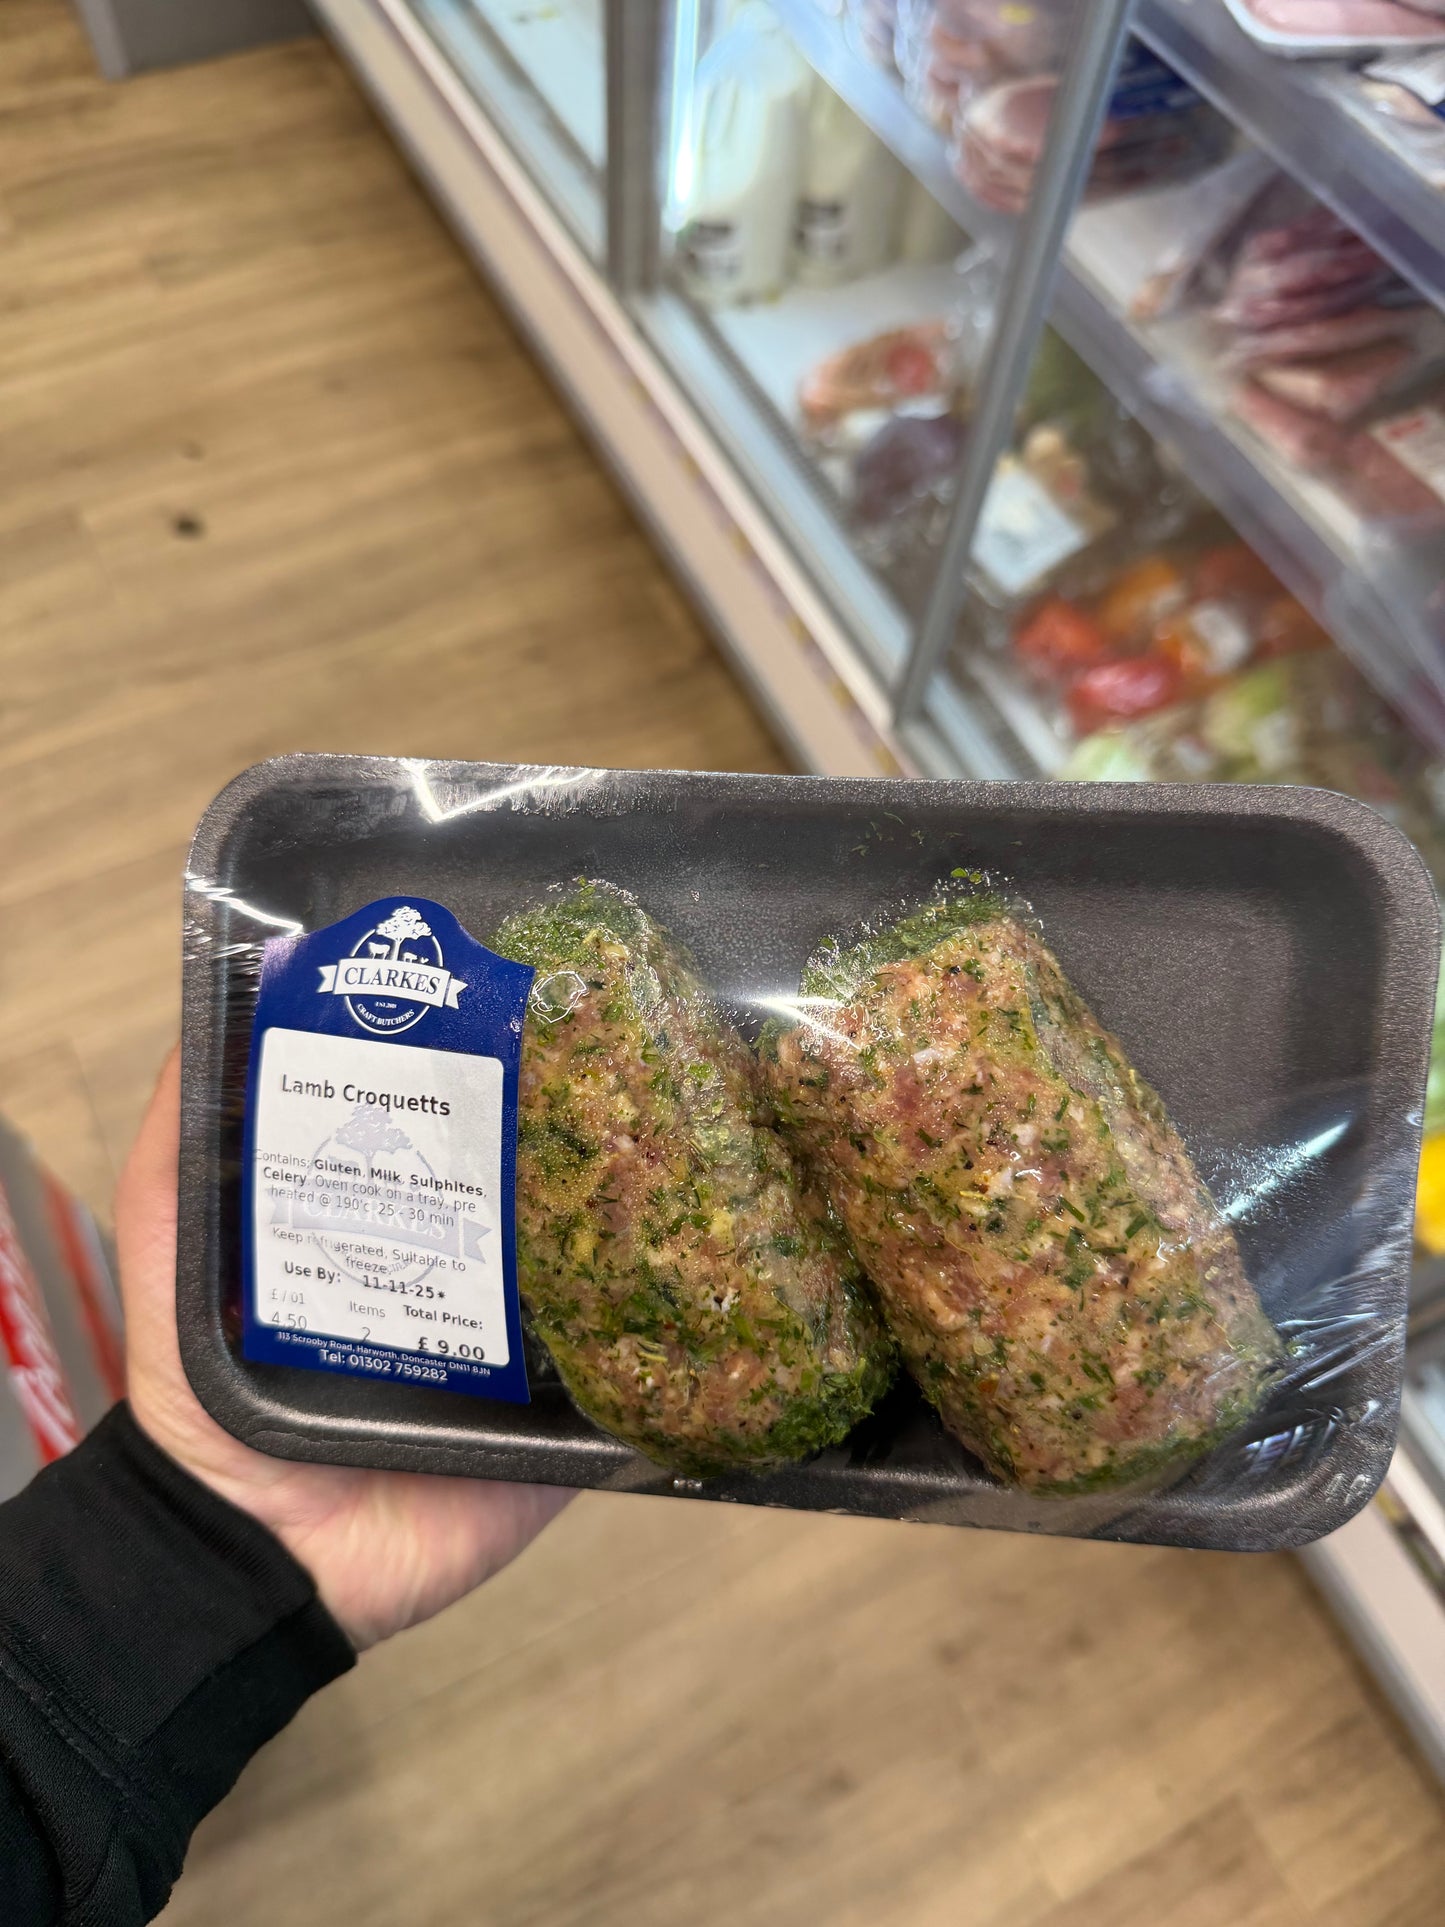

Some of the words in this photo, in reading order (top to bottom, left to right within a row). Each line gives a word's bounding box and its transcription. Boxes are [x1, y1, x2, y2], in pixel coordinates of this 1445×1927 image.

[344, 966, 440, 995] CLARKES
[357, 1003, 377, 1023] CRAFT
[376, 1009, 415, 1025] BUTCHERS
[281, 1074, 335, 1099] Lamb
[343, 1084, 451, 1116] Croquetts
[314, 1158, 366, 1178] Gluten,
[370, 1167, 405, 1185] Milk,
[410, 1174, 487, 1198] Sulphites,
[315, 1174, 348, 1191] Oven
[352, 1182, 381, 1196] cook
[386, 1188, 402, 1199] on
[406, 1192, 414, 1202] a
[454, 1200, 477, 1213] pre
[271, 1184, 315, 1203] heated
[319, 1194, 331, 1207] @
[378, 1202, 395, 1217] 25
[408, 1207, 425, 1222] 30
[430, 1212, 455, 1227] min
[273, 1227, 303, 1246] Keep
[392, 1248, 447, 1269] Suitable
[452, 1259, 466, 1272] to
[284, 1261, 312, 1277] Use
[317, 1267, 341, 1284] By:
[349, 1300, 386, 1318] Items
[403, 1304, 437, 1321] Total
[442, 1312, 483, 1330] Price:
[292, 1334, 328, 1347] Scrooby
[329, 1340, 355, 1352] Road,
[357, 1345, 399, 1360] Harworth,
[401, 1353, 446, 1367] Doncaster
[449, 1361, 471, 1372] DN11
[319, 1349, 346, 1364] Tel:
[348, 1353, 392, 1372] 01302
[395, 1362, 448, 1381] 759282
[437, 1340, 485, 1361] 9.00
